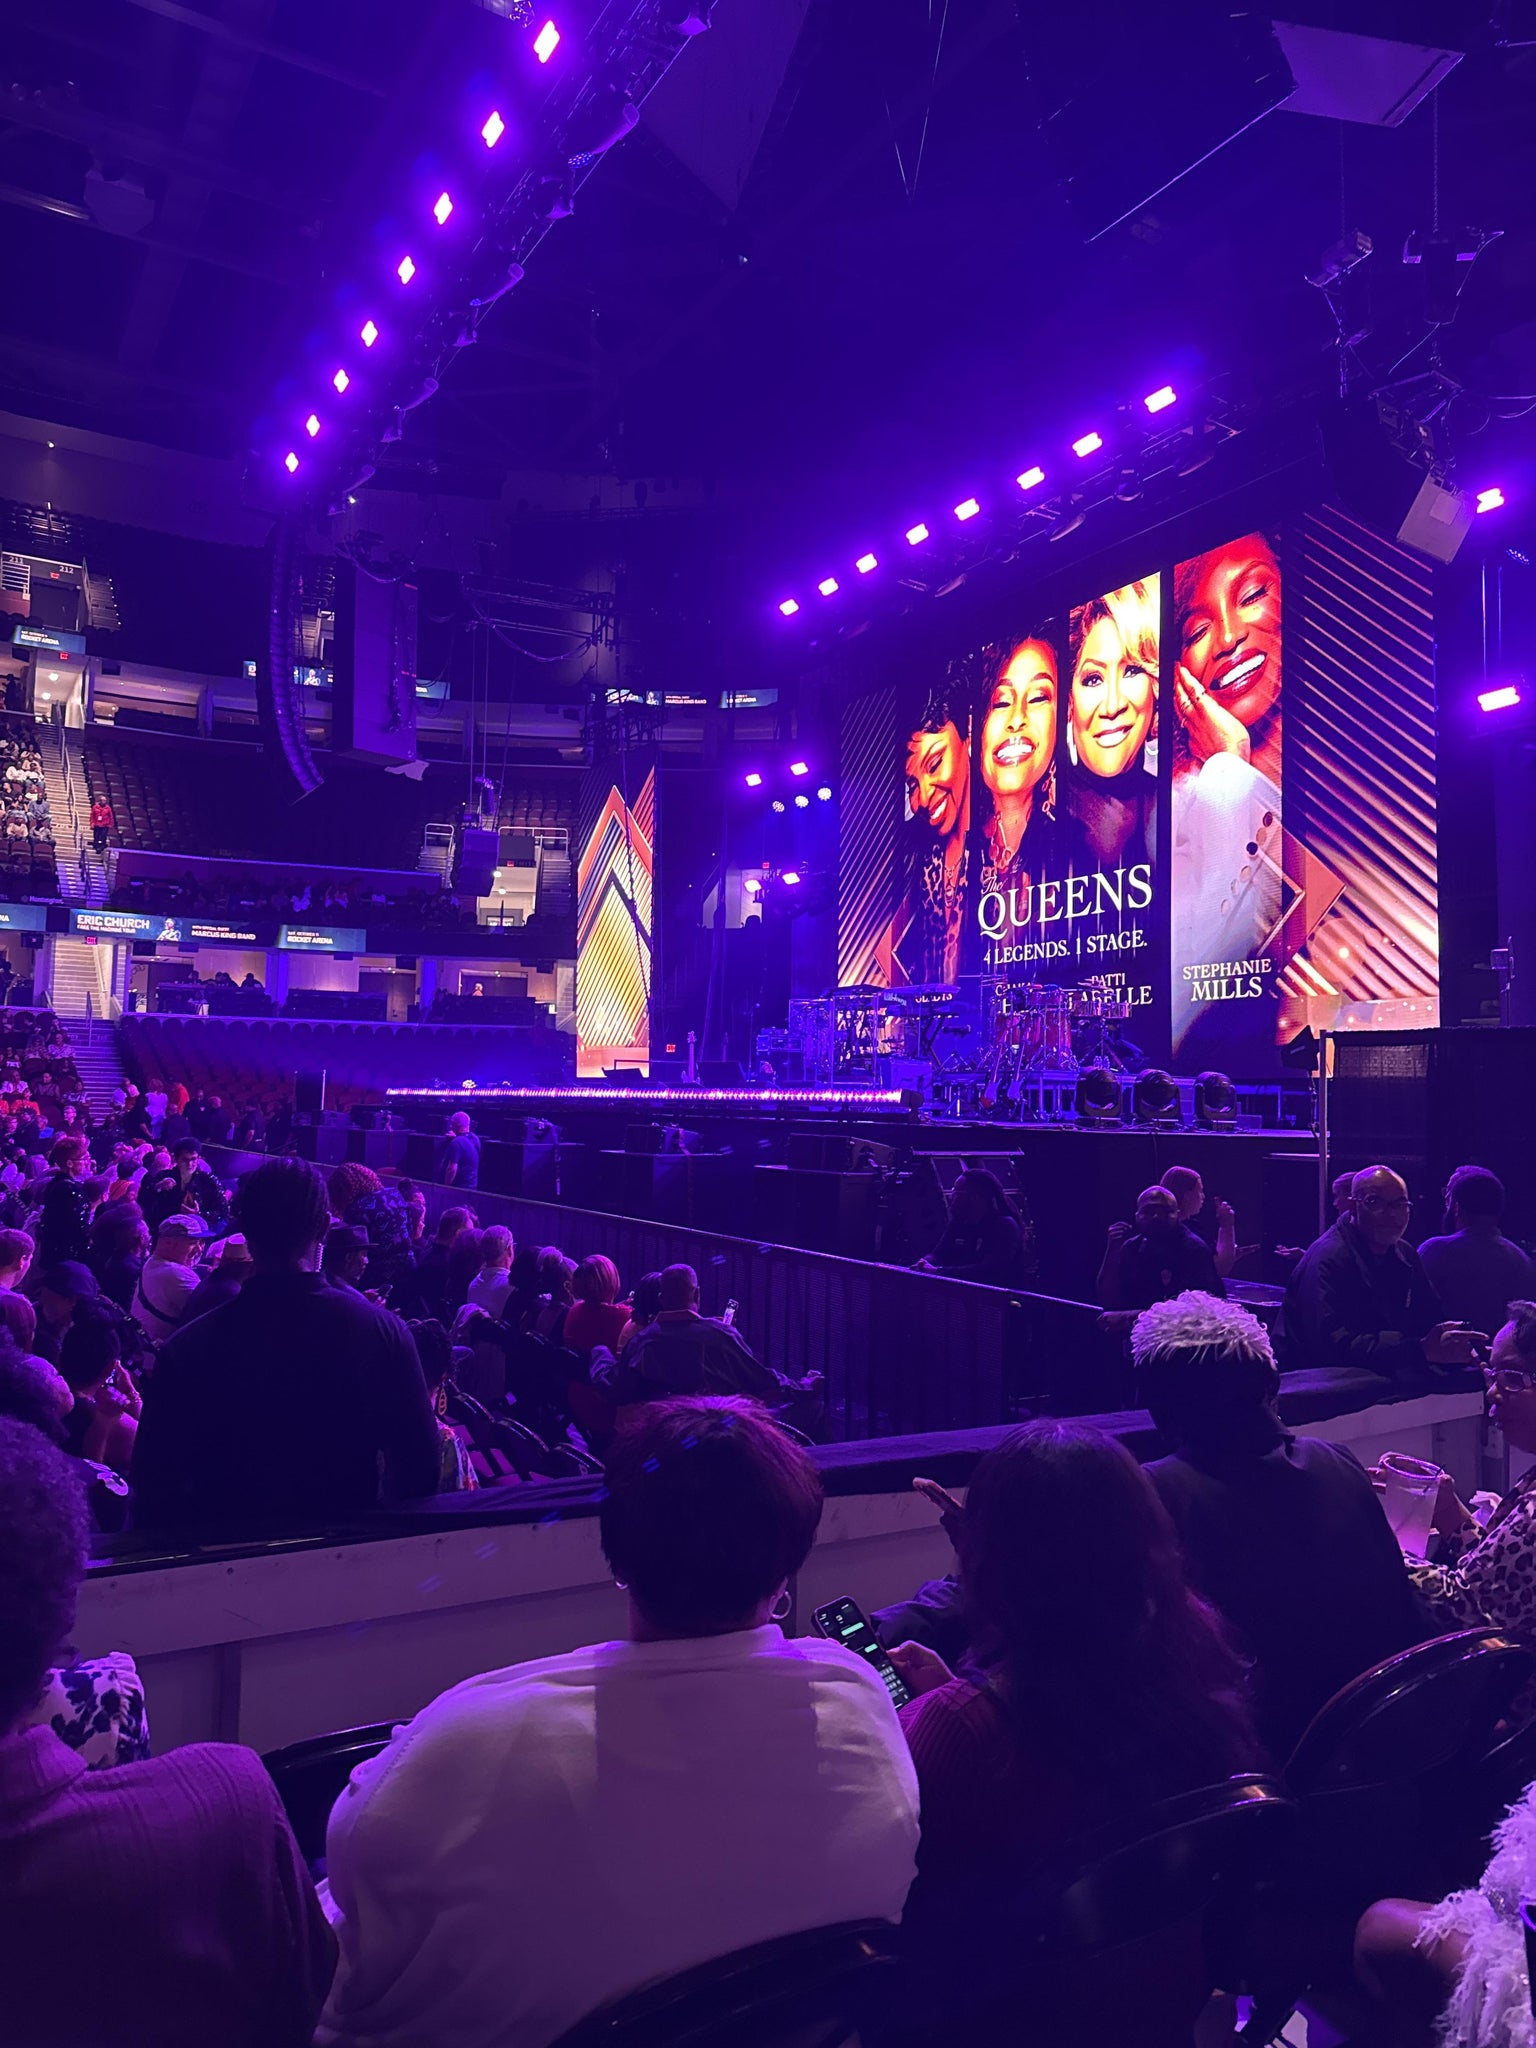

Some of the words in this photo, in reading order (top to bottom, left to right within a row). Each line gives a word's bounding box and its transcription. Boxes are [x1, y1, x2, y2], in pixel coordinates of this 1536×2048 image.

[9, 555, 24, 565] 211
[59, 566, 74, 574] 212
[980, 876, 1007, 895] The
[977, 864, 1153, 940] QUEENS
[77, 914, 103, 926] ERIC
[104, 916, 150, 929] CHURCH
[191, 930, 220, 938] MARCUS
[312, 937, 333, 945] ARENA
[983, 949, 992, 965] 4
[994, 939, 1071, 965] LEGENDS.
[1075, 938, 1082, 955] 1
[1086, 929, 1148, 954] STAGE.
[1182, 958, 1272, 980] STEPHANIE
[1190, 976, 1263, 1002] MILLS
